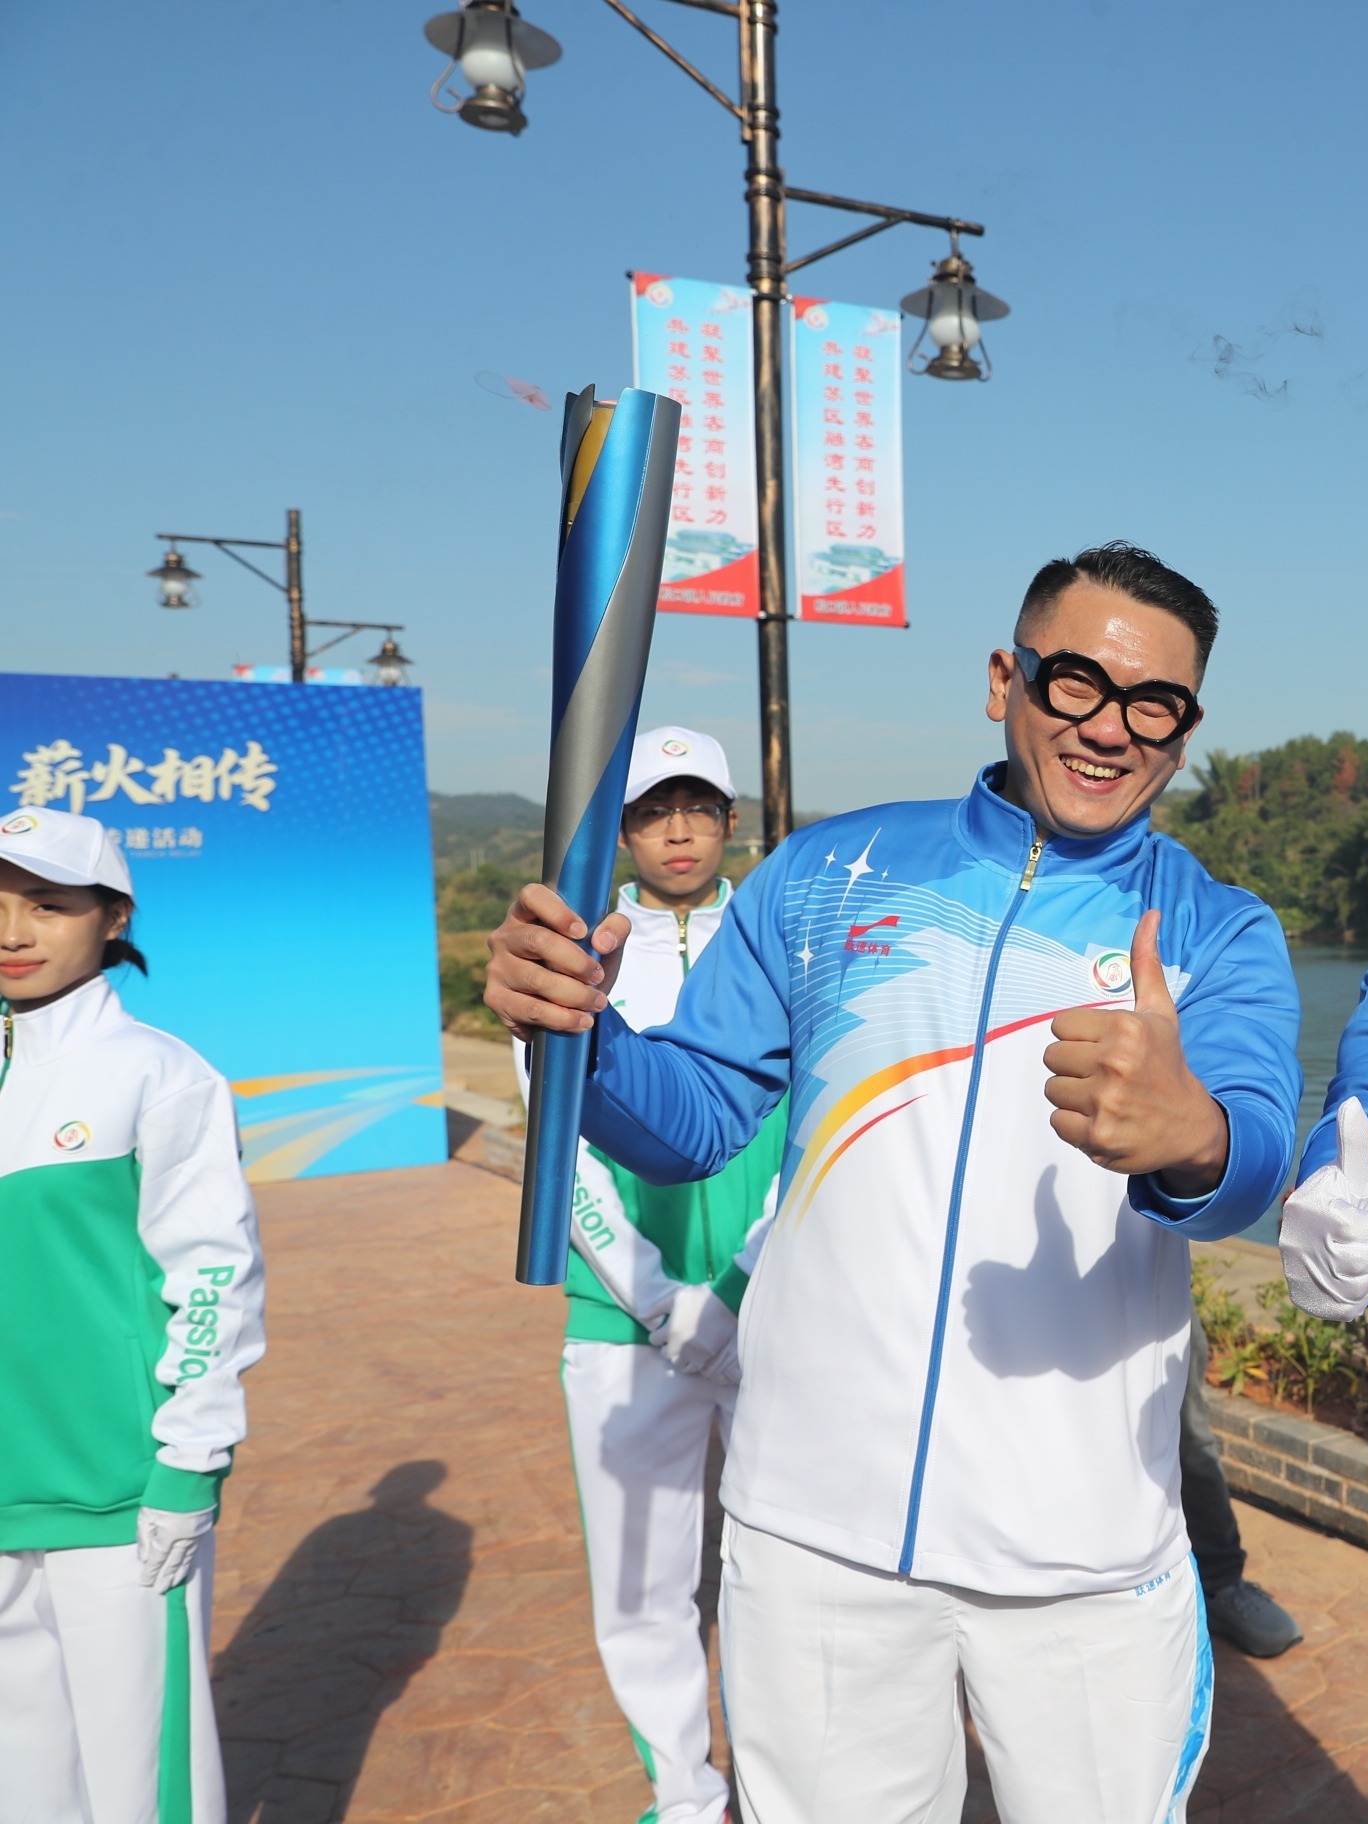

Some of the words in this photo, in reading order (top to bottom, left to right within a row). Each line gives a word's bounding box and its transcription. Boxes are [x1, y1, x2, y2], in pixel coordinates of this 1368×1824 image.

[9, 739, 279, 815] 薪火相传
[176, 1264, 236, 1384] Passio
